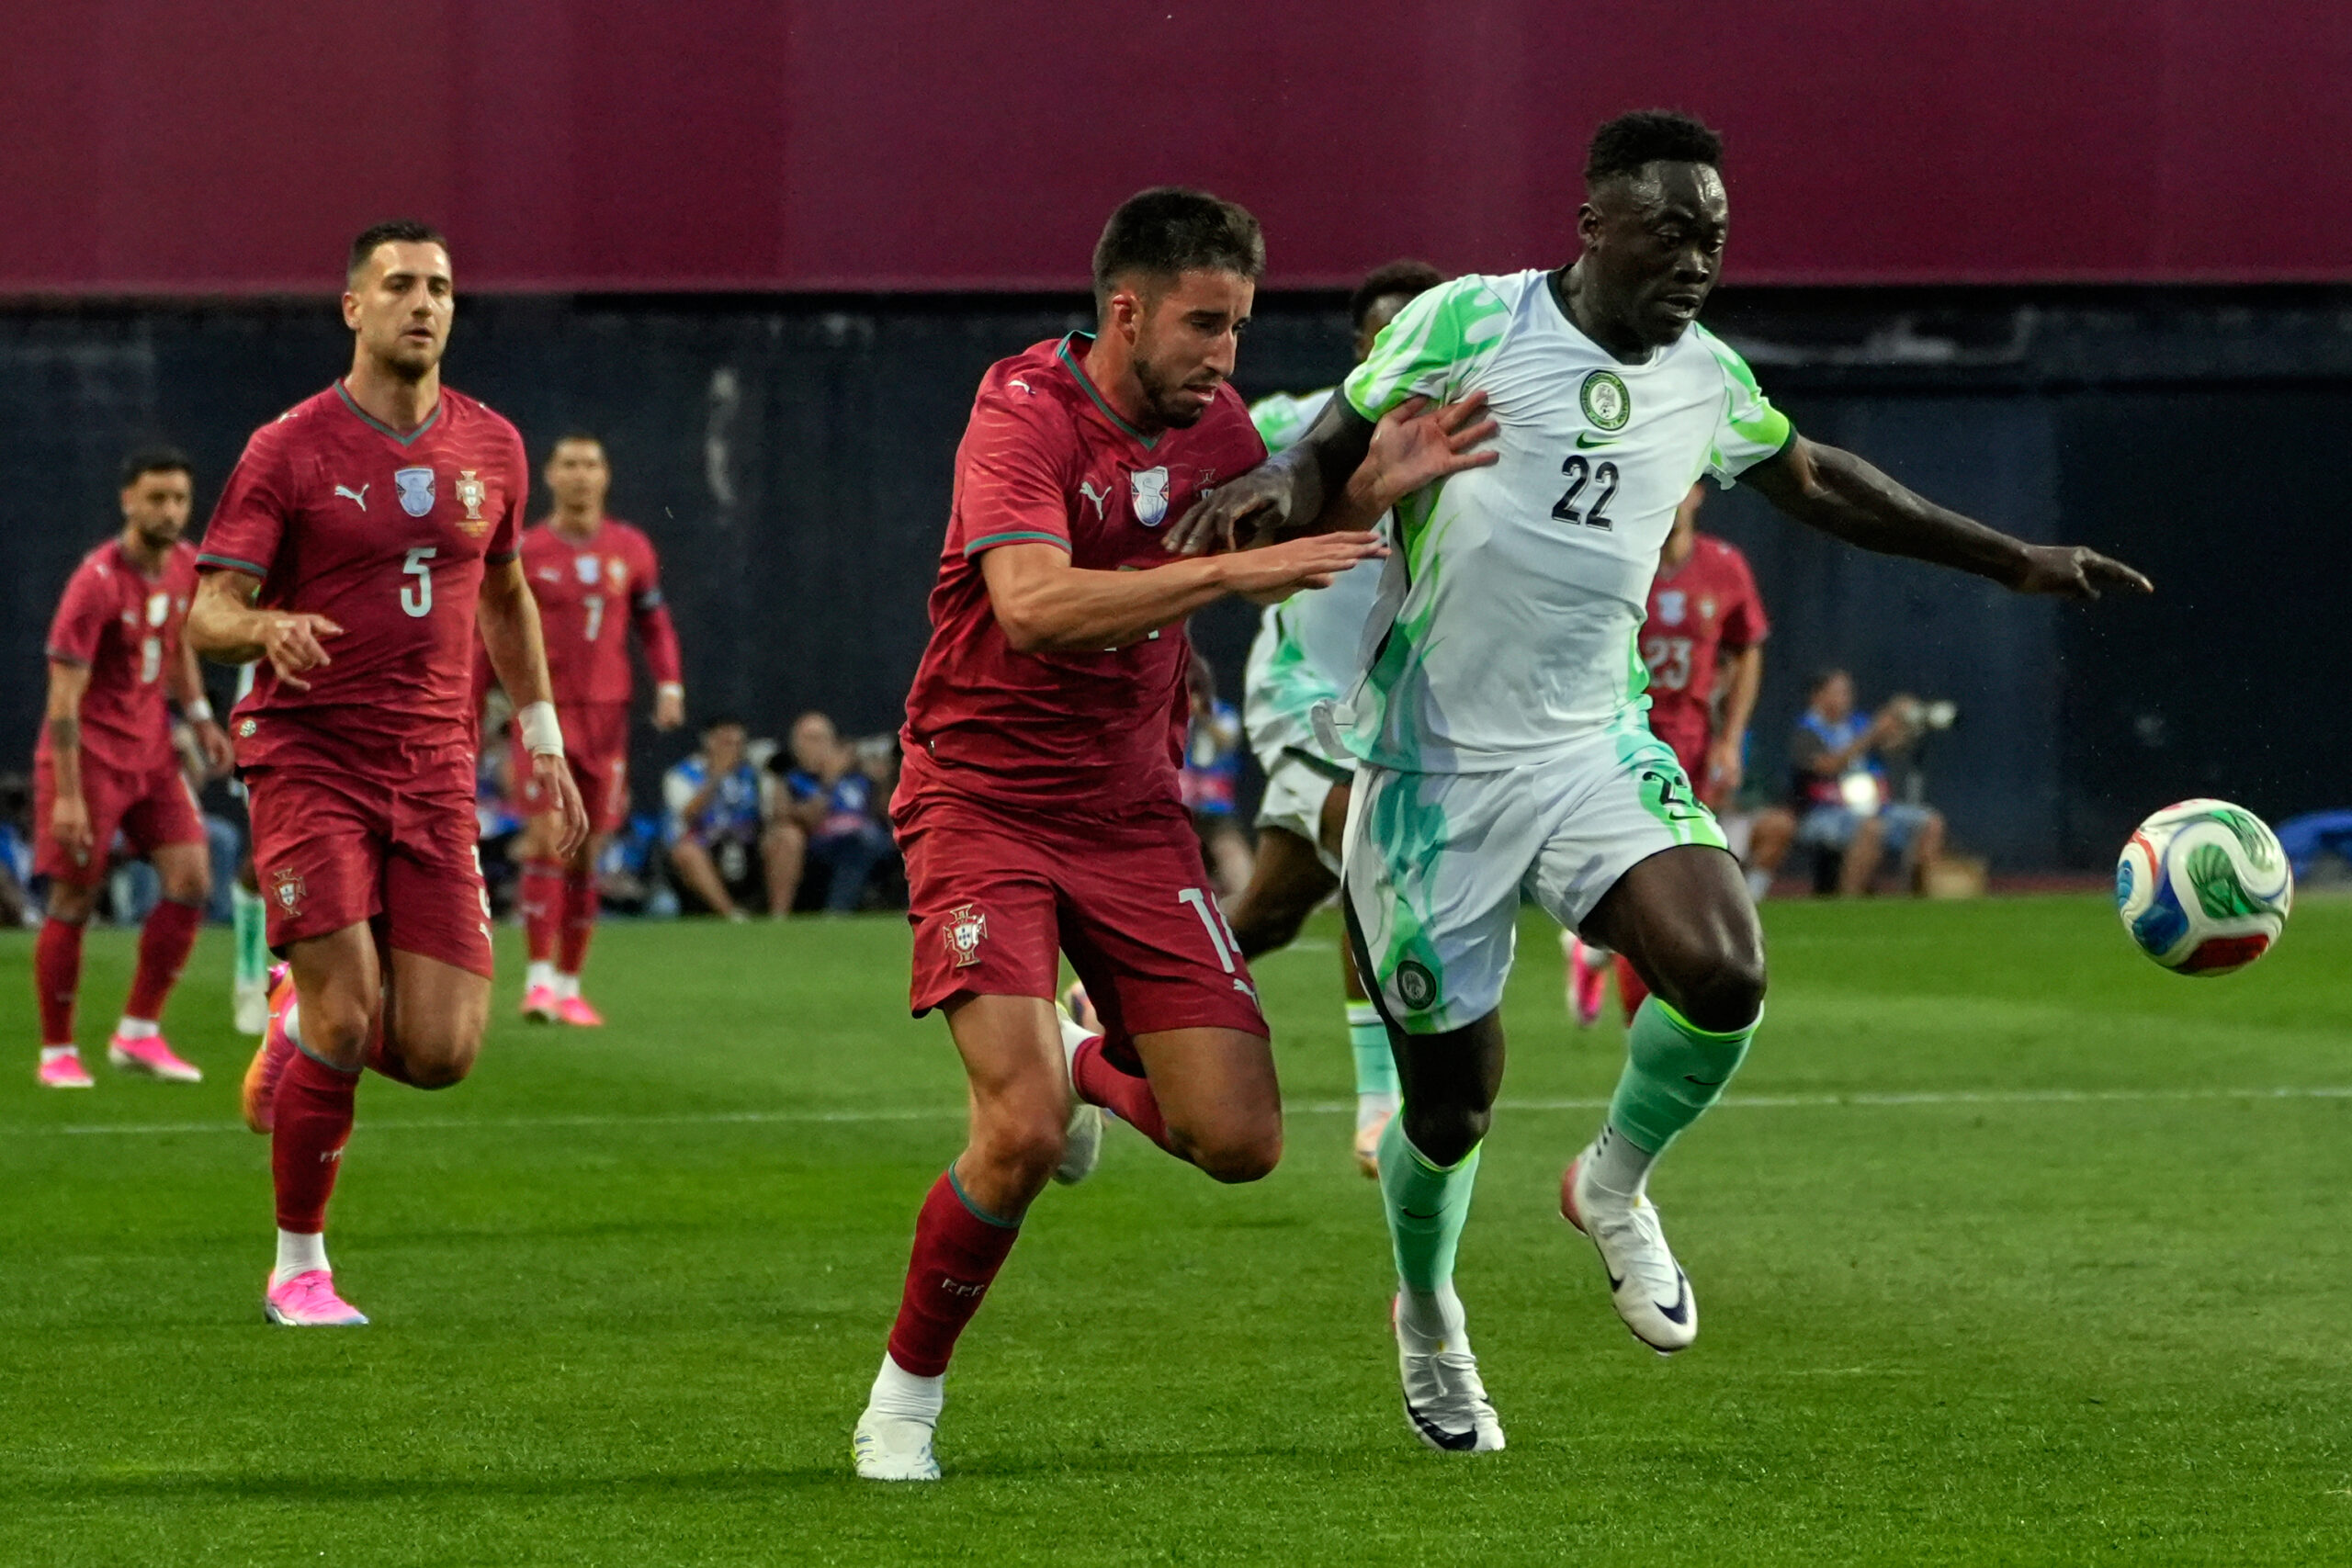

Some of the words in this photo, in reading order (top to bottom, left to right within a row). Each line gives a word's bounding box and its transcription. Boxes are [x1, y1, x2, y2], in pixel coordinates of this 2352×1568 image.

[1552, 455, 1619, 532] 22
[400, 547, 436, 617] 5
[1645, 637, 1692, 691] 23
